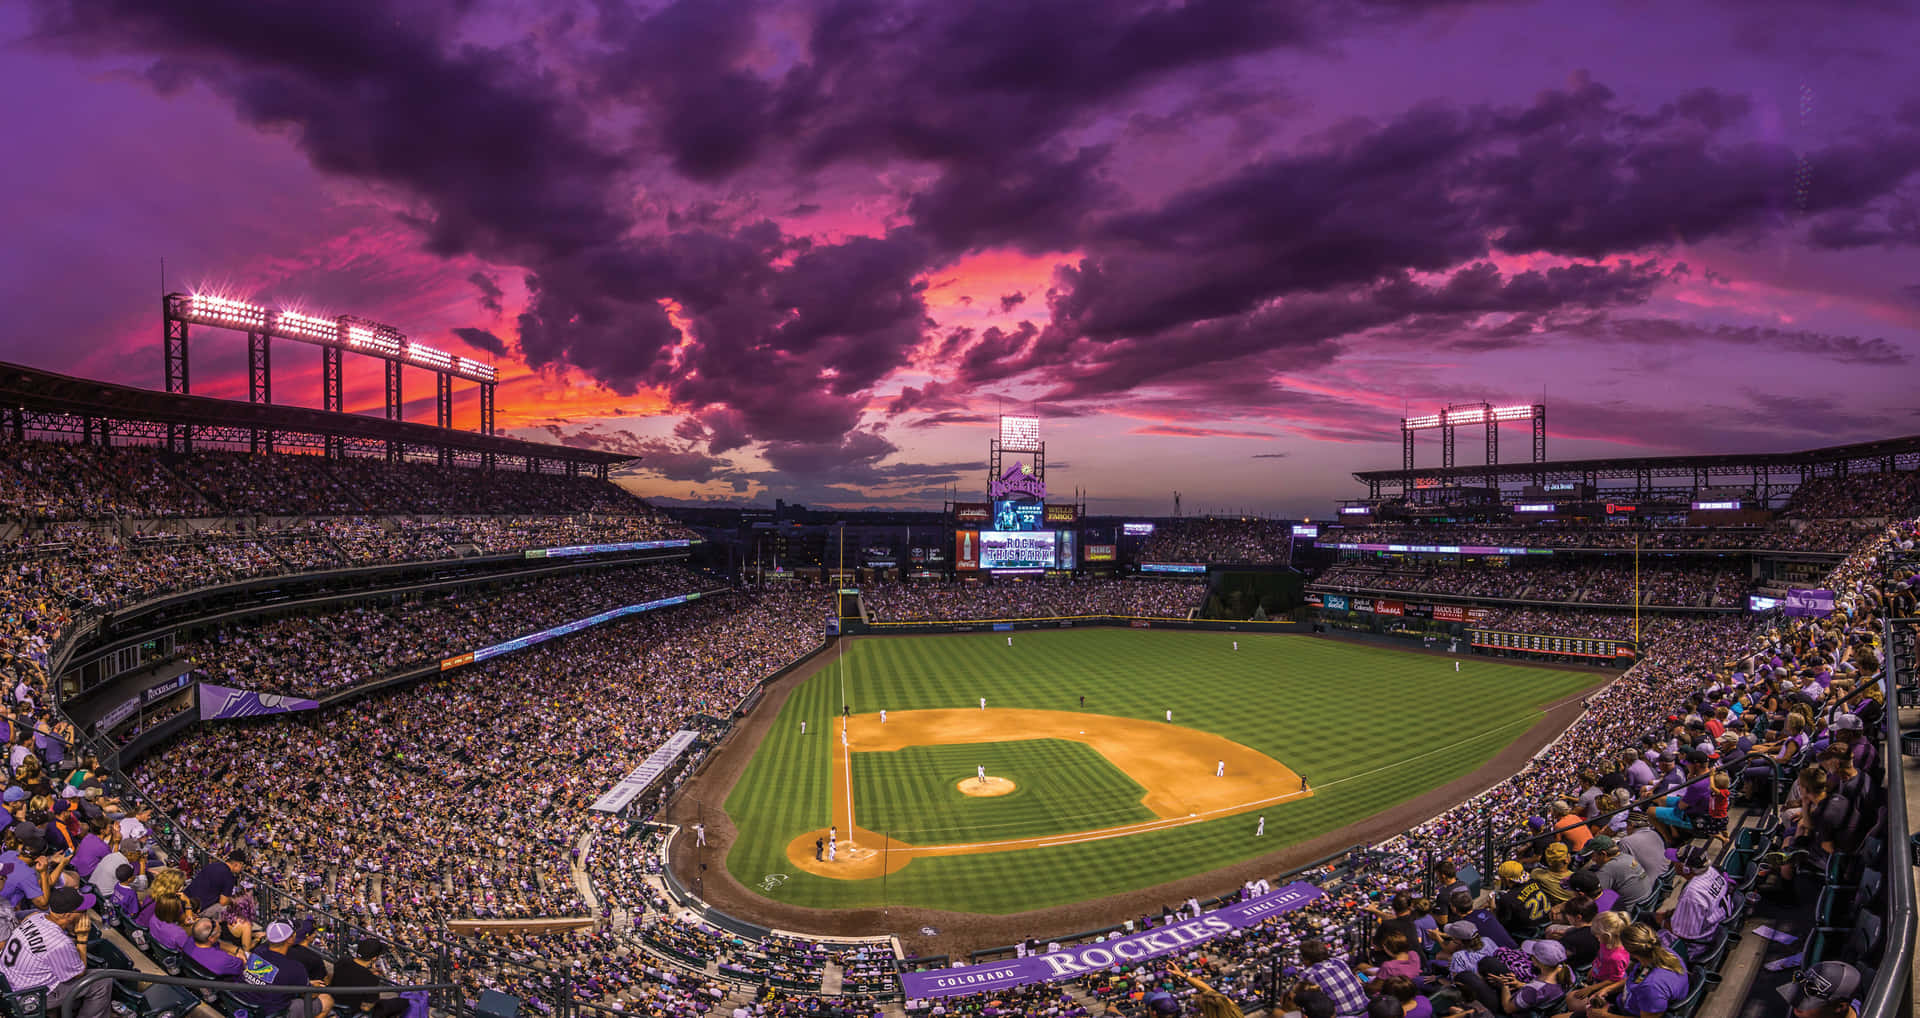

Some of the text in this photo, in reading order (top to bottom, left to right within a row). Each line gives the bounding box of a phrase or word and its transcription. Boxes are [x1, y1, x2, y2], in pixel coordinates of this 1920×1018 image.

[990, 480, 1046, 498] ROCKIES
[1006, 538, 1036, 548] ROCK
[989, 550, 1015, 560] THIS
[1243, 902, 1275, 915] SINCE
[1525, 891, 1551, 920] 22
[1040, 916, 1232, 977] ROCKIES
[937, 969, 1015, 988] COLORADO
